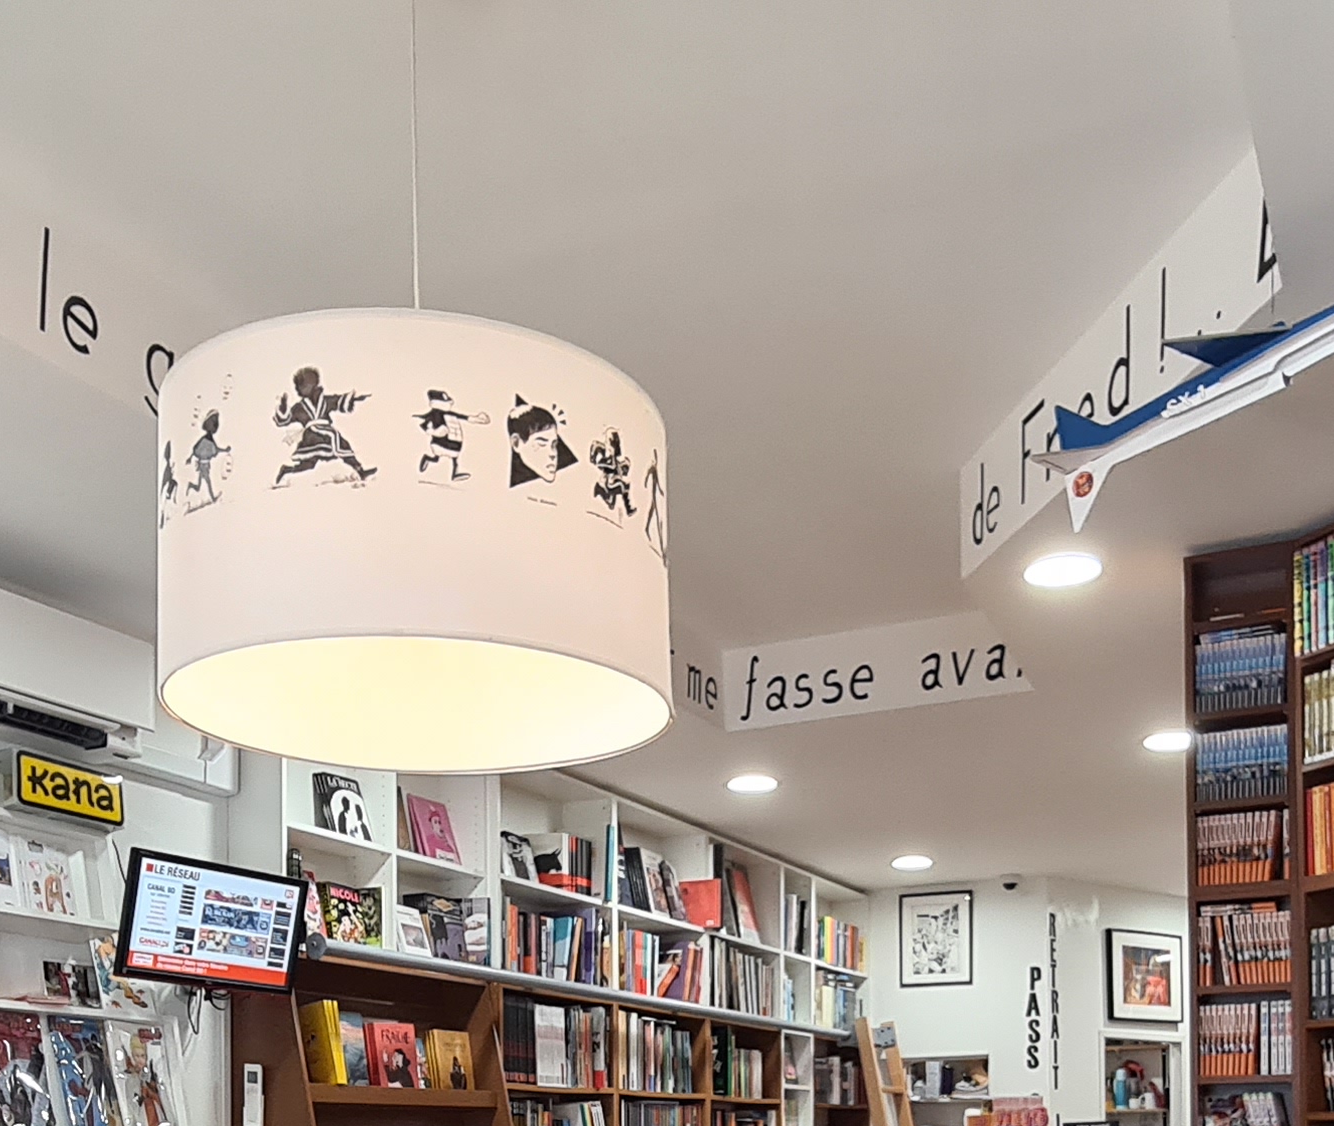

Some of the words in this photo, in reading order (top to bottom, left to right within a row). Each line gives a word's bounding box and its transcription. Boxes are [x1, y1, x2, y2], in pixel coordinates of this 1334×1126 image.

[39, 227, 99, 355] le
[972, 462, 1000, 546] de
[686, 663, 718, 711] me
[739, 655, 874, 721] fasse
[28, 762, 114, 813] kana
[154, 864, 166, 875] LE
[167, 866, 201, 881] RÉSEAU
[1025, 966, 1043, 1070] PASS
[1049, 912, 1060, 1091] RETRAIT
